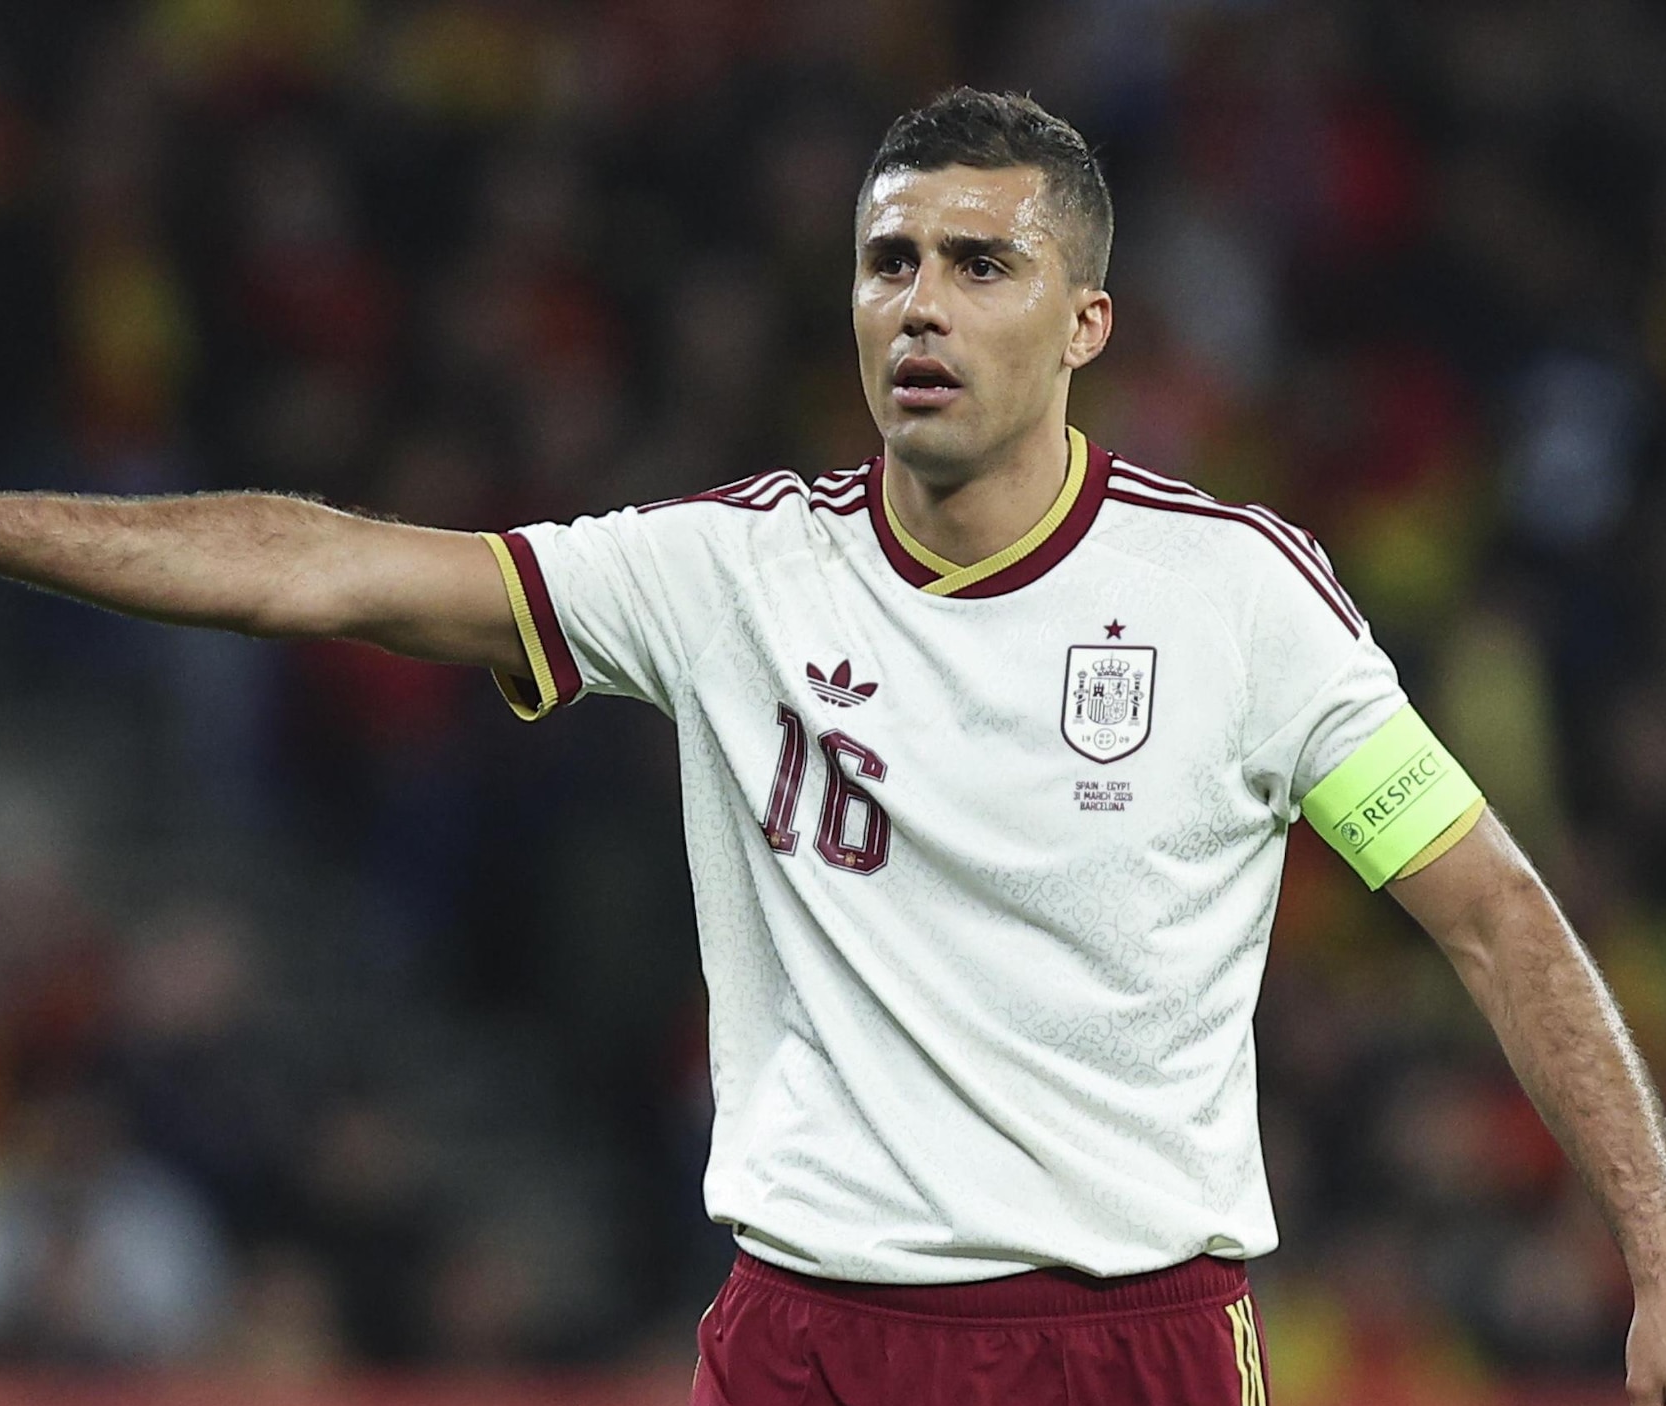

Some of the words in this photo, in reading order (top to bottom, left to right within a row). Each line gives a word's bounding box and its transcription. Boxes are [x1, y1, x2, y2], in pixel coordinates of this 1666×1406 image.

[757, 701, 892, 876] 16
[1075, 781, 1099, 790] SPAIN
[1362, 752, 1441, 827] RESPECT
[1083, 791, 1111, 801] MARCH
[1079, 801, 1126, 812] BARCELONA
